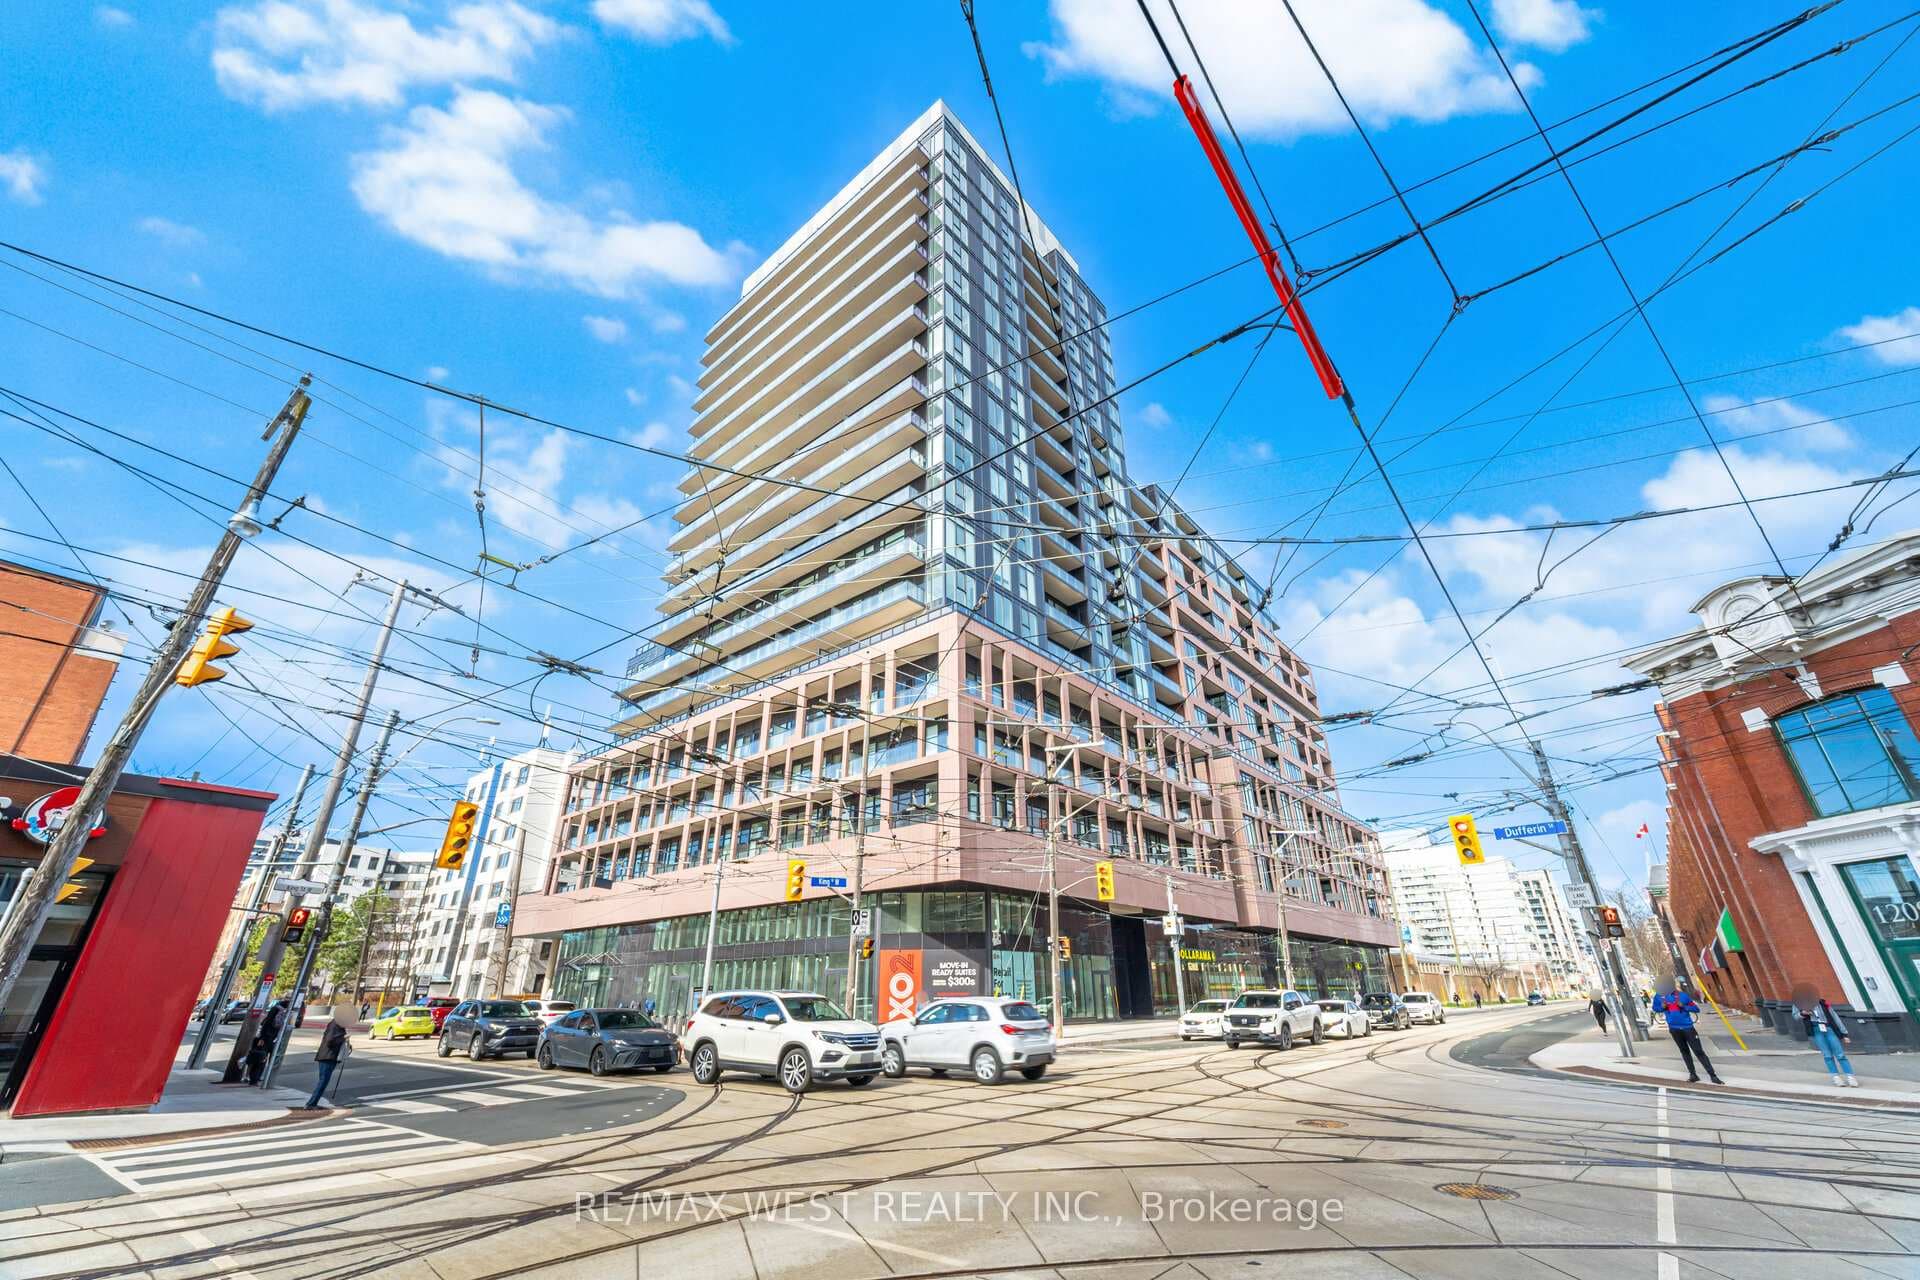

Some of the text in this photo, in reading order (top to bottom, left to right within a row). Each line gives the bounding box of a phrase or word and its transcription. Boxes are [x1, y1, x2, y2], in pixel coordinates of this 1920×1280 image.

[1504, 824, 1547, 837] Dufferin
[819, 878, 830, 887] King
[1178, 949, 1212, 961] OLLARAMA
[993, 967, 1012, 977] Retail
[948, 976, 975, 987] $300s
